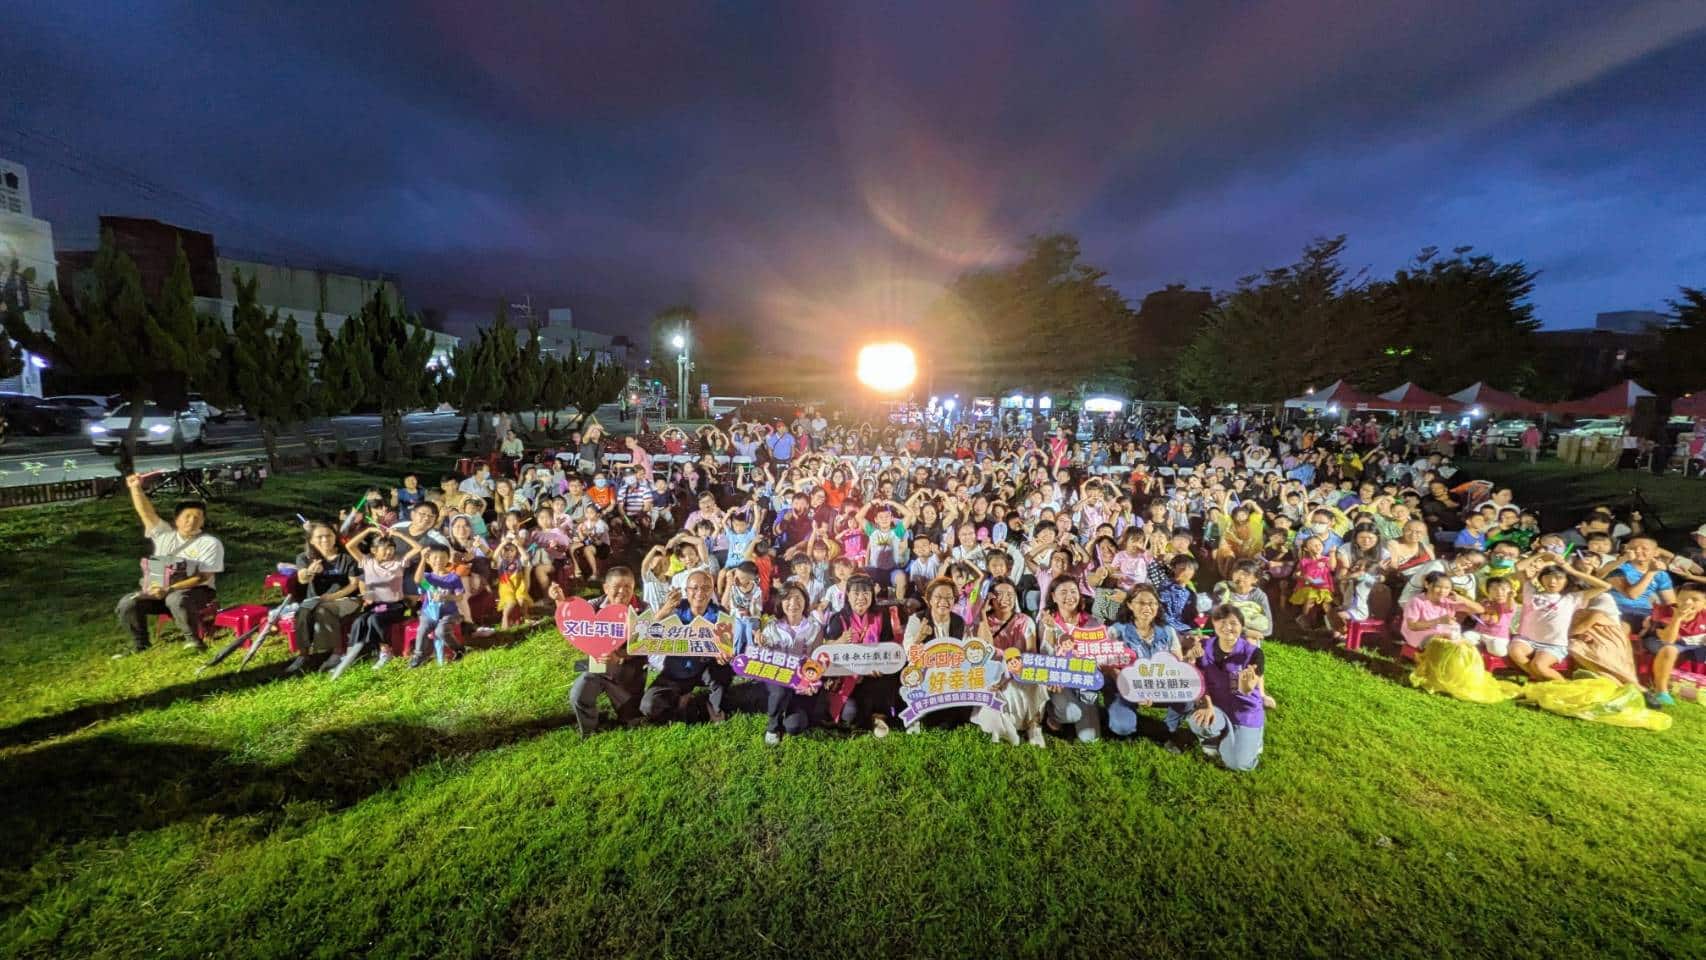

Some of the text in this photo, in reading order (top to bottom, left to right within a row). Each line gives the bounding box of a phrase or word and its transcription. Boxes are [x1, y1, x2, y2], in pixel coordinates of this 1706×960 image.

[563, 620, 625, 638] 文化平權
[928, 666, 985, 693] 好幸福
